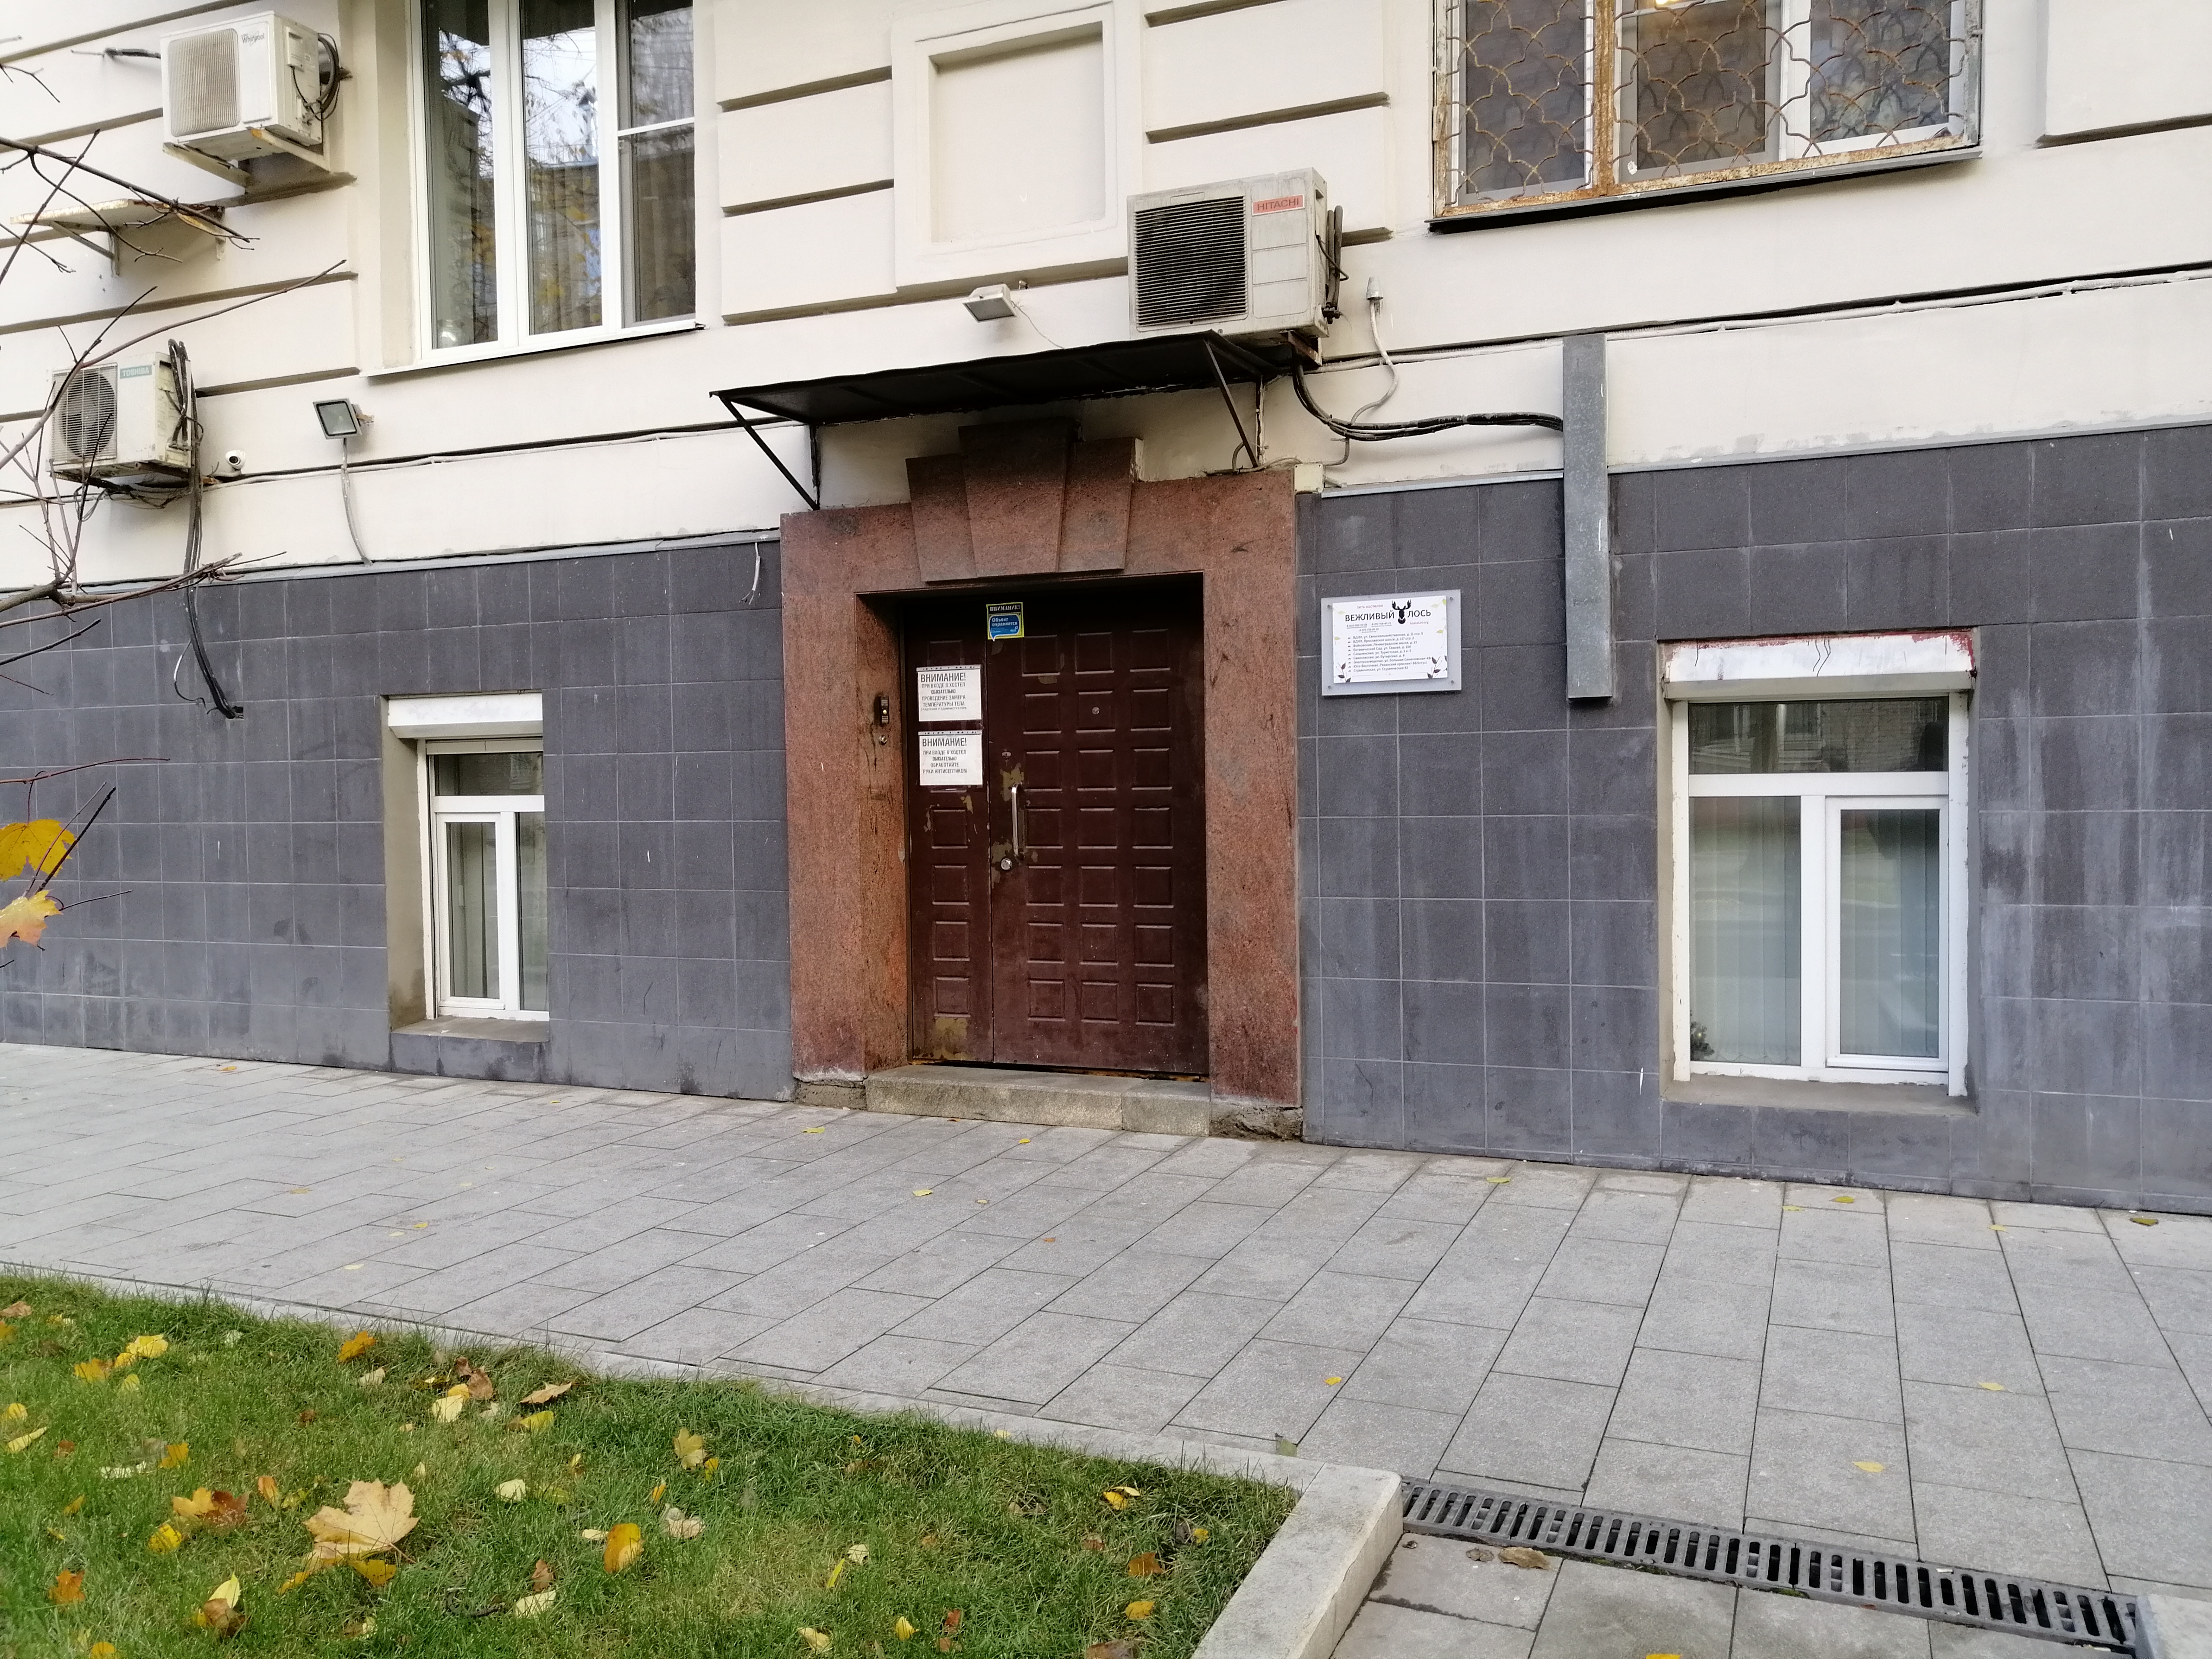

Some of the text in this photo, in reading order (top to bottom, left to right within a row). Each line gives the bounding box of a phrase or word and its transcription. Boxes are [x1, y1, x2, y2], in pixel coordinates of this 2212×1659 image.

[242, 33, 264, 43] Whirlpool
[1257, 197, 1299, 210] HITACHI
[122, 367, 149, 376] TOSHIBA
[1345, 609, 1431, 621] ВЕЖЛИВЫЙ ЛОСЬ
[921, 673, 966, 682] ВНИМАНИЕ!
[922, 737, 967, 747] ВНИМАНИЕ!
